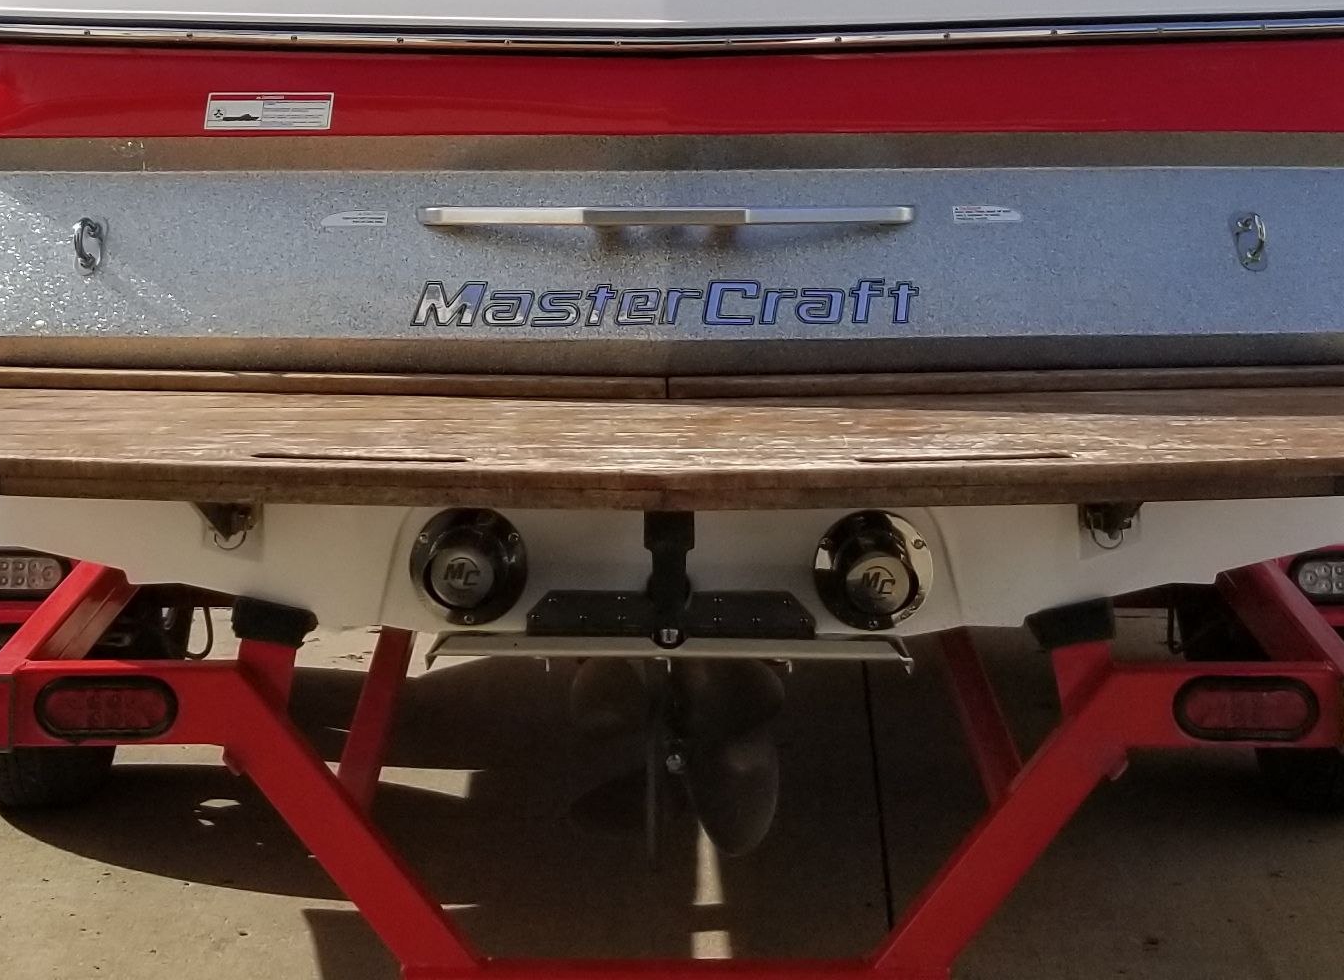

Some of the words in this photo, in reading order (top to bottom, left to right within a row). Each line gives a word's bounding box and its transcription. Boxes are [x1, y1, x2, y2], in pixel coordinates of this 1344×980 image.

[410, 278, 920, 327] MasterCraft
[443, 561, 481, 586] MC
[860, 571, 896, 595] MC
